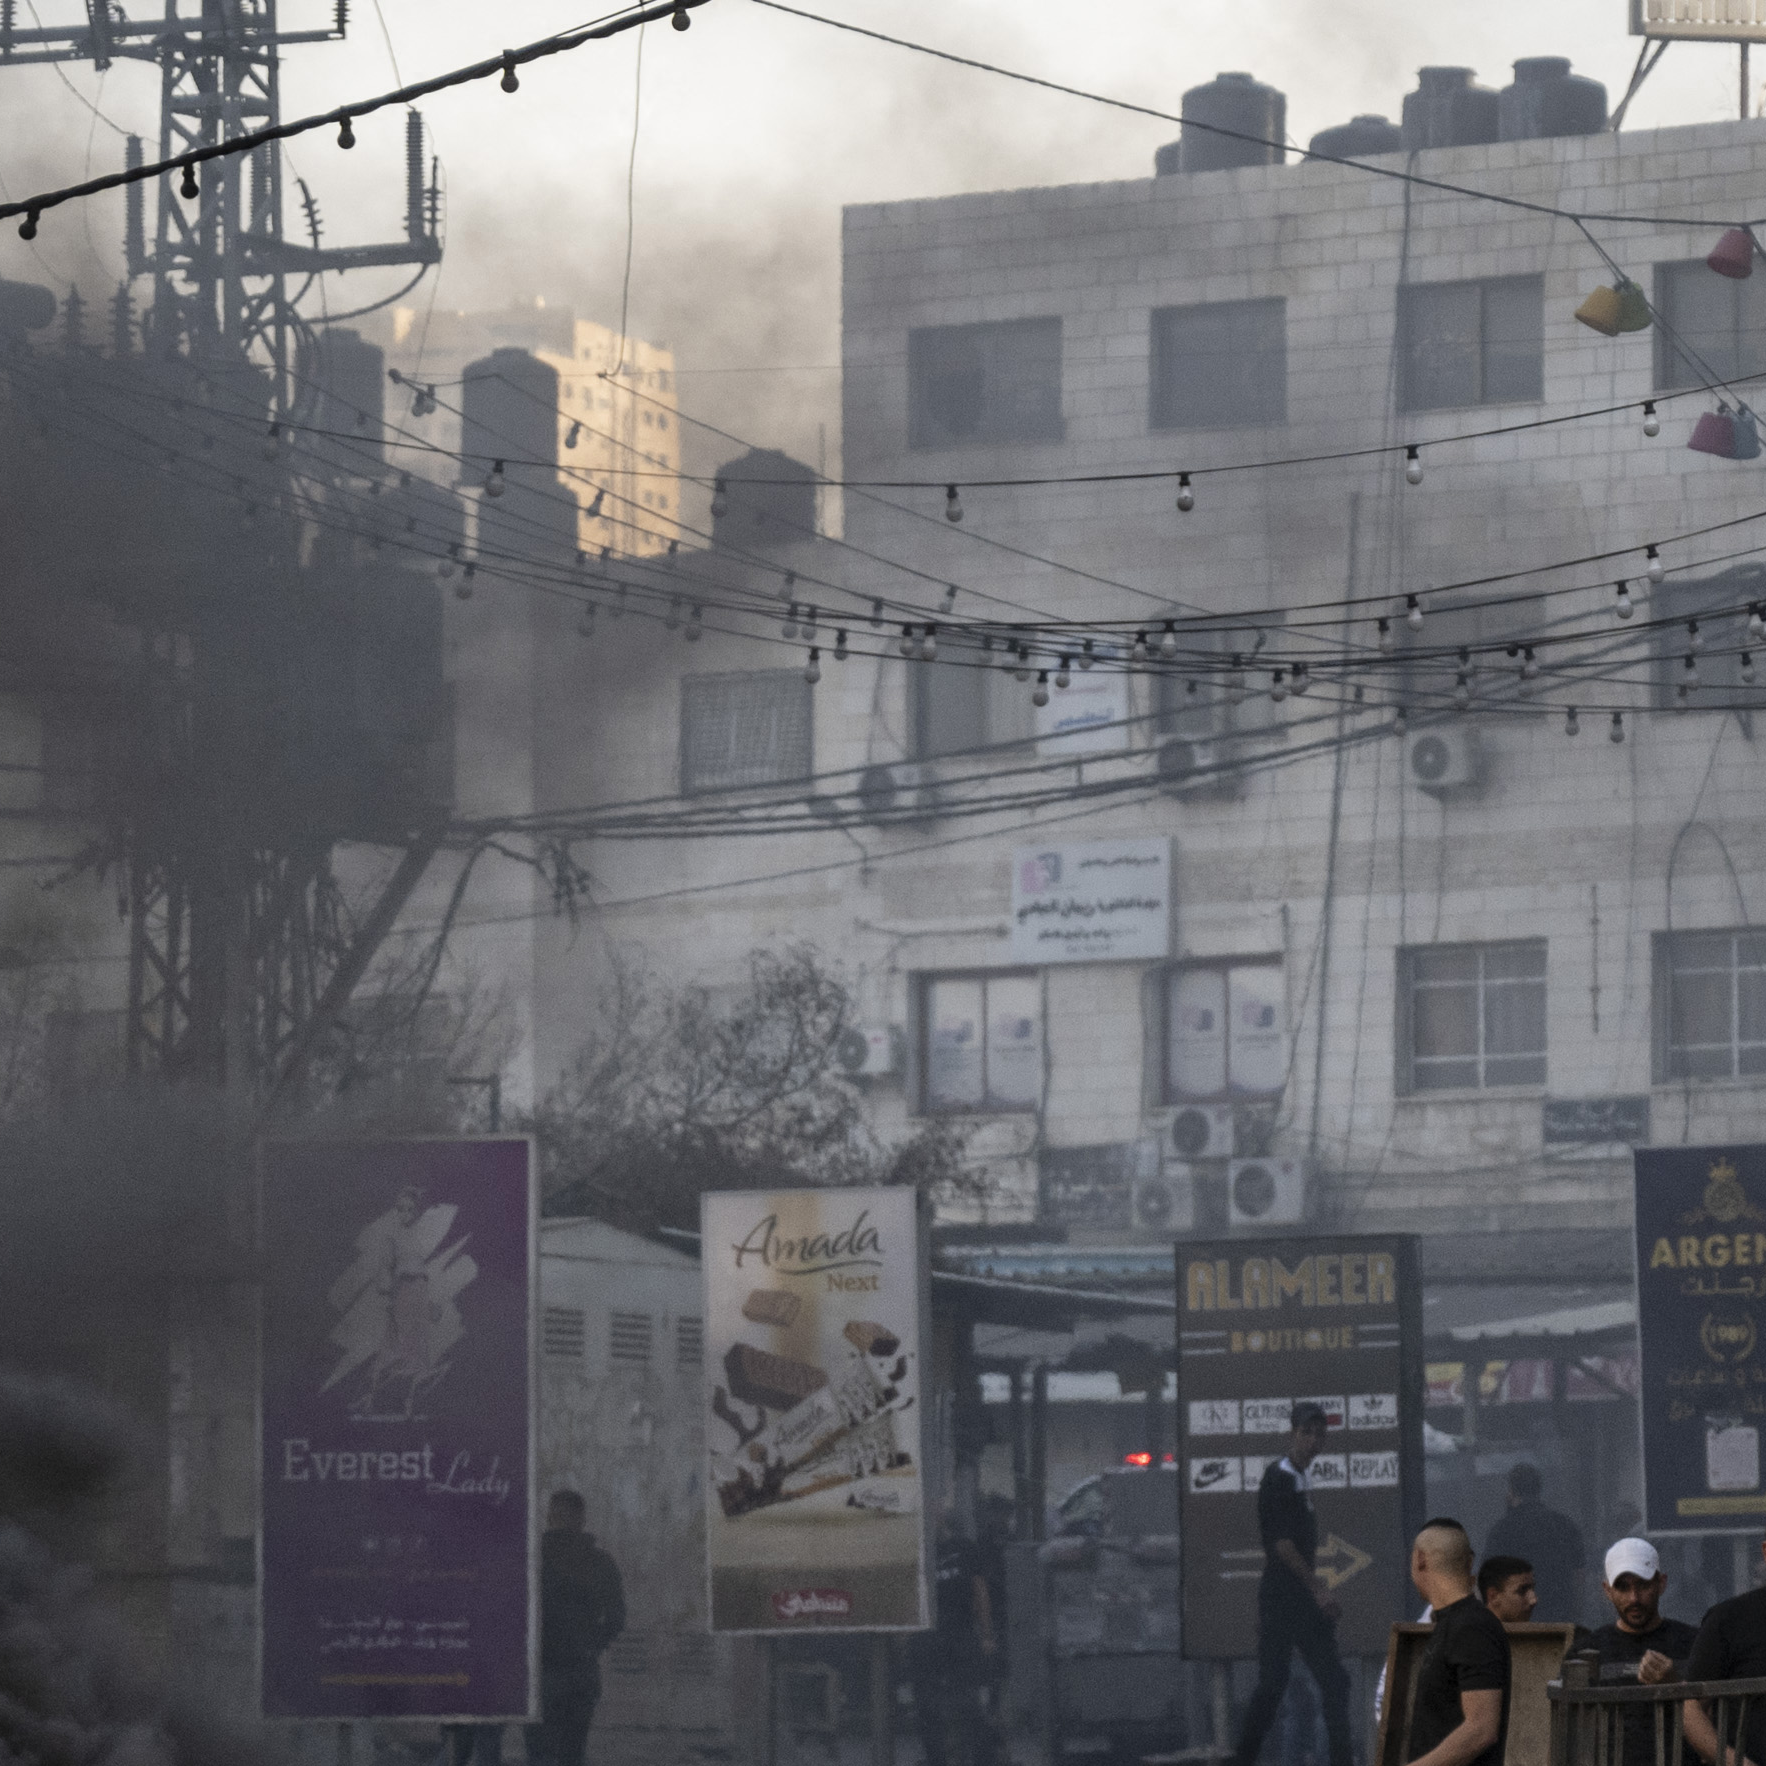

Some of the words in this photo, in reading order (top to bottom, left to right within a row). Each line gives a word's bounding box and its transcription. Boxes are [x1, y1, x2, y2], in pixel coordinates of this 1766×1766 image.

[731, 1210, 885, 1270] Amada
[826, 1273, 880, 1293] Next
[1187, 1253, 1396, 1311] ALAMEER
[1229, 1325, 1353, 1354] BOUTIQUE
[282, 1438, 435, 1481] Everest
[426, 1448, 511, 1505] Lady
